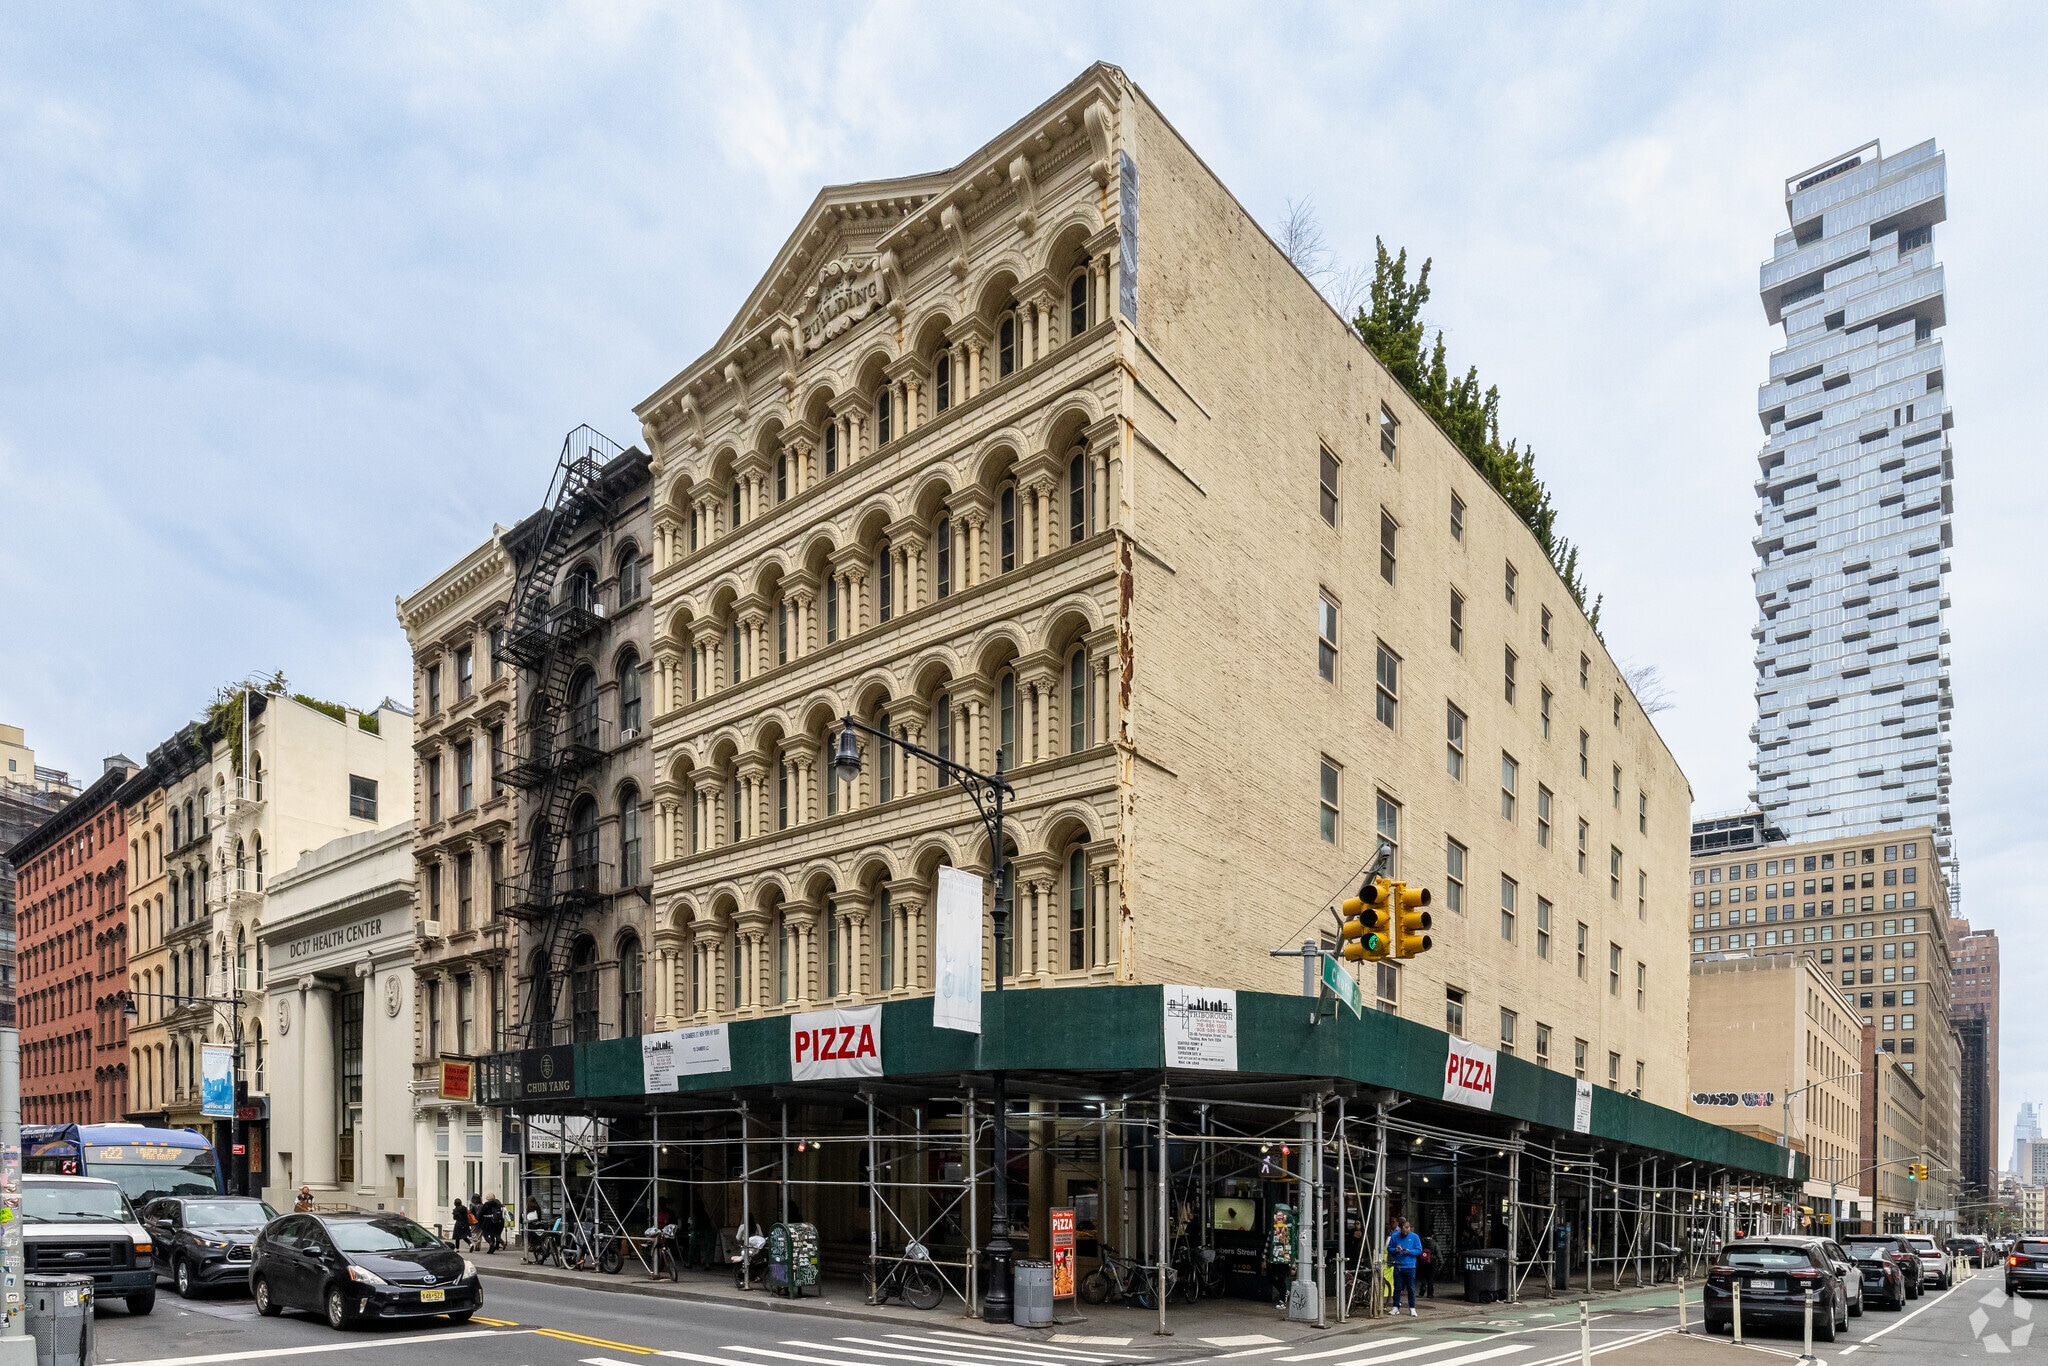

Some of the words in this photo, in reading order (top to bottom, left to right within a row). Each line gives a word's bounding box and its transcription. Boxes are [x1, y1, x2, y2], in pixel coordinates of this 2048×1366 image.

[802, 281, 877, 343] BUILDING
[313, 929, 344, 952] HEALTH
[346, 918, 382, 943] CENTER
[1189, 1012, 1233, 1020] TRIBOROUGH
[795, 1024, 877, 1063] PIZZA
[1447, 1052, 1491, 1094] PIZZA
[527, 1082, 547, 1093] CHUN
[548, 1080, 570, 1091] YANG
[1052, 1218, 1073, 1231] PIZZA
[1236, 1248, 1257, 1256] Street
[1466, 1257, 1490, 1265] LITTLE
